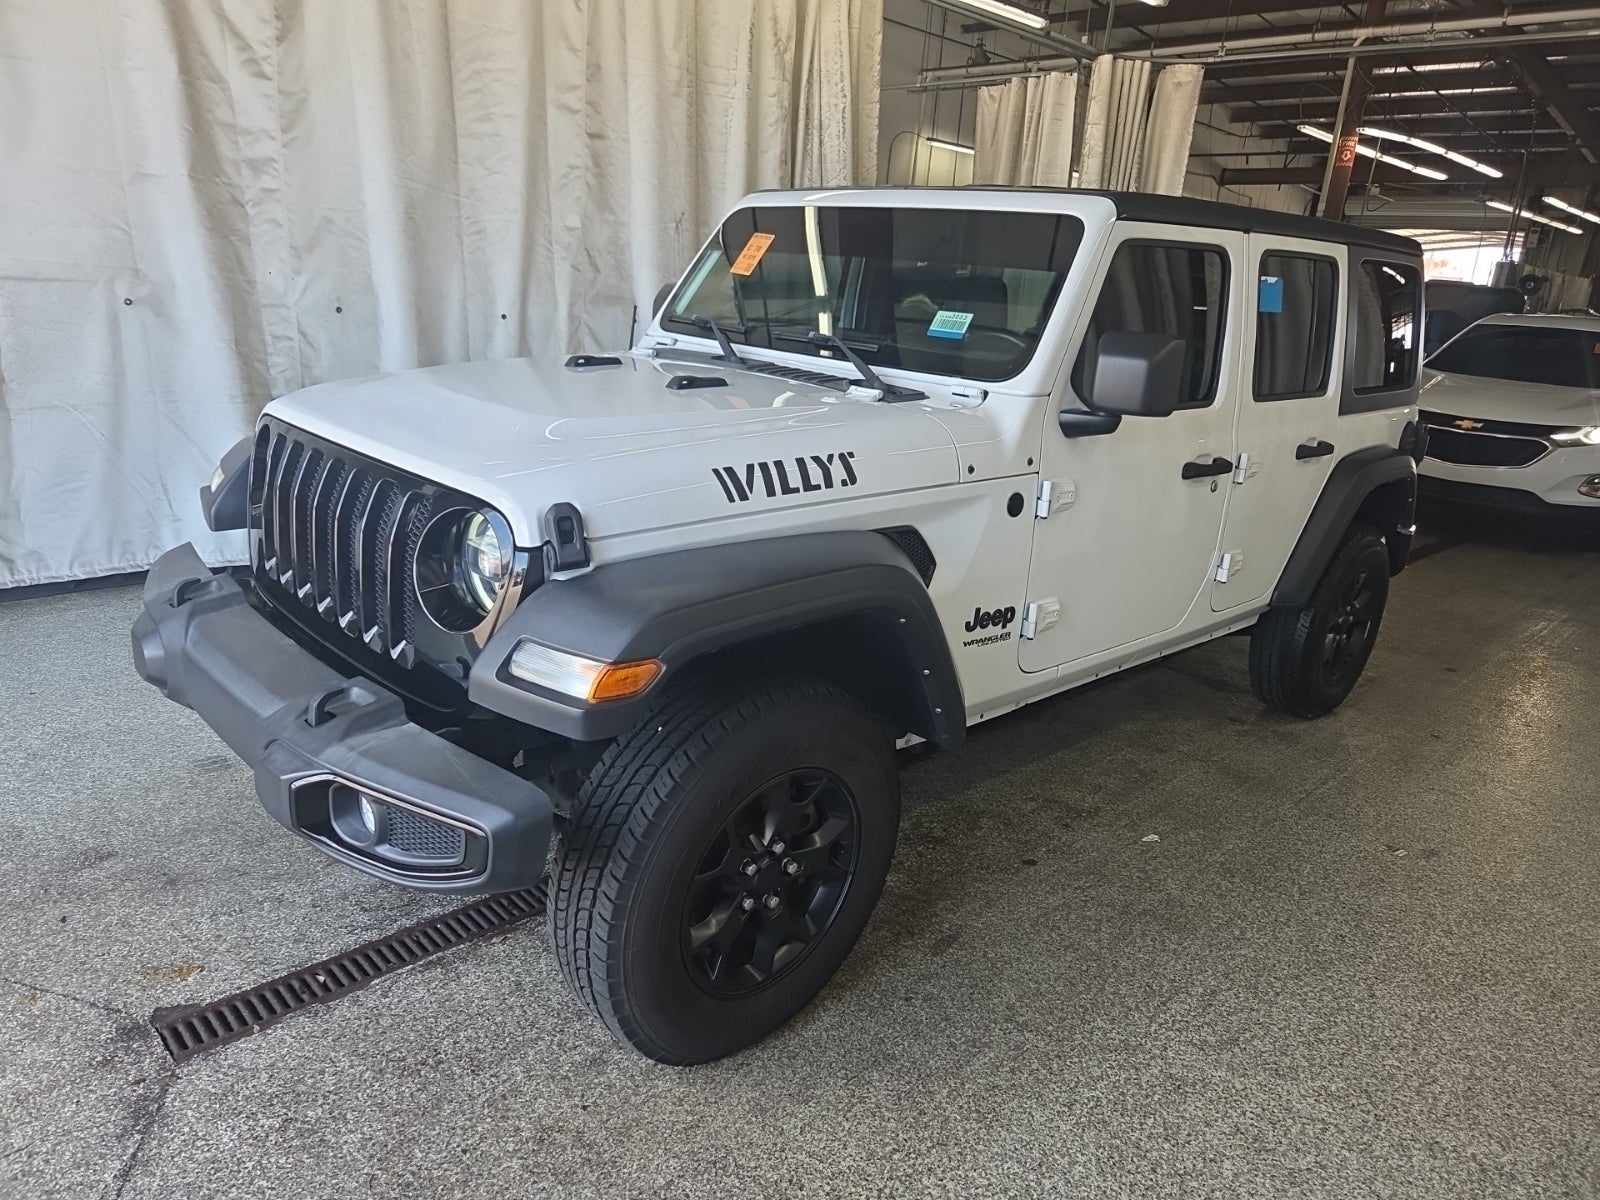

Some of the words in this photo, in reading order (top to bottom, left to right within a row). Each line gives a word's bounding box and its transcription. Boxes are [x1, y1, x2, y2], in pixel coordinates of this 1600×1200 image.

[711, 451, 858, 503] WILLYS
[965, 606, 1016, 632] Jeep
[963, 631, 1012, 647] WRANGLER
